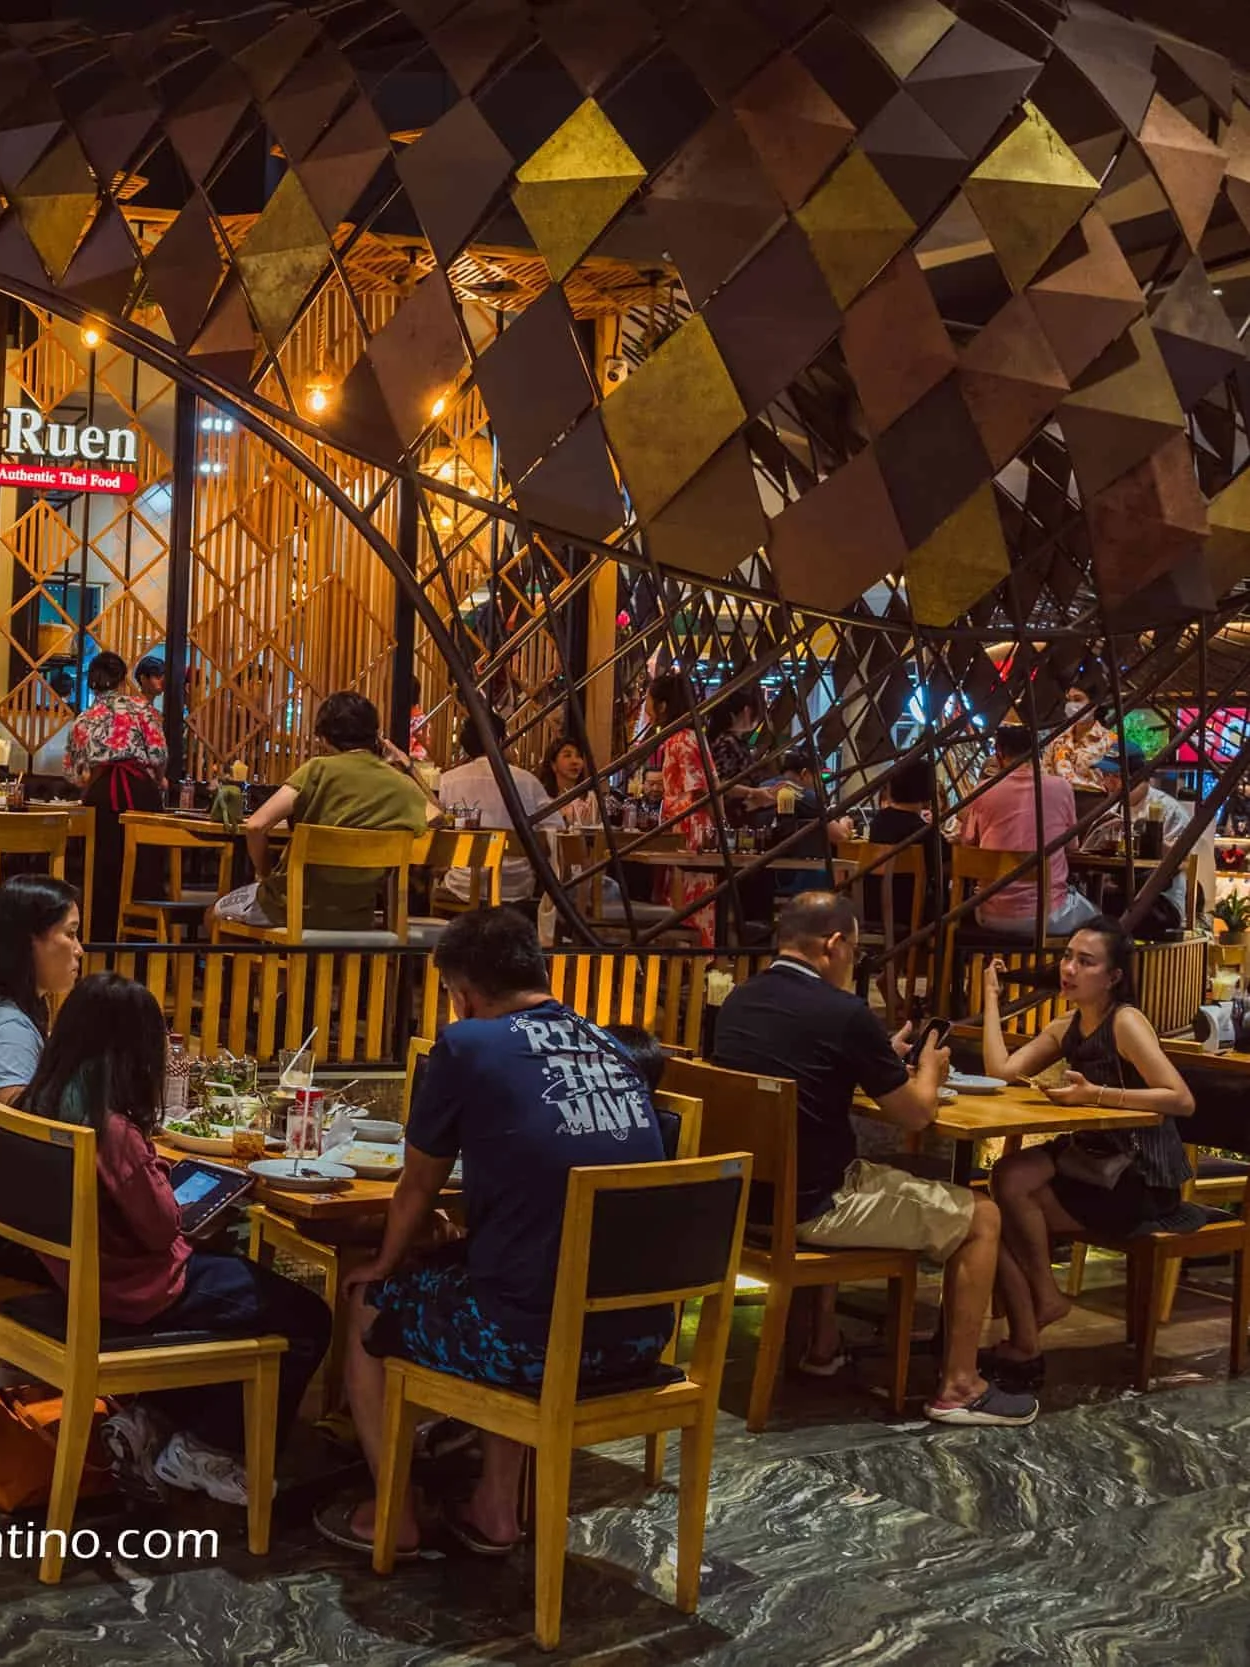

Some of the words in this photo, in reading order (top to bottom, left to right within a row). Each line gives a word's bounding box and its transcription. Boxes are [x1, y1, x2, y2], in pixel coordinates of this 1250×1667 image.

[5, 407, 138, 462] Ruen
[60, 471, 87, 487] Thai
[90, 474, 121, 489] Food
[548, 1051, 629, 1090] THE
[557, 1090, 651, 1136] WAVE
